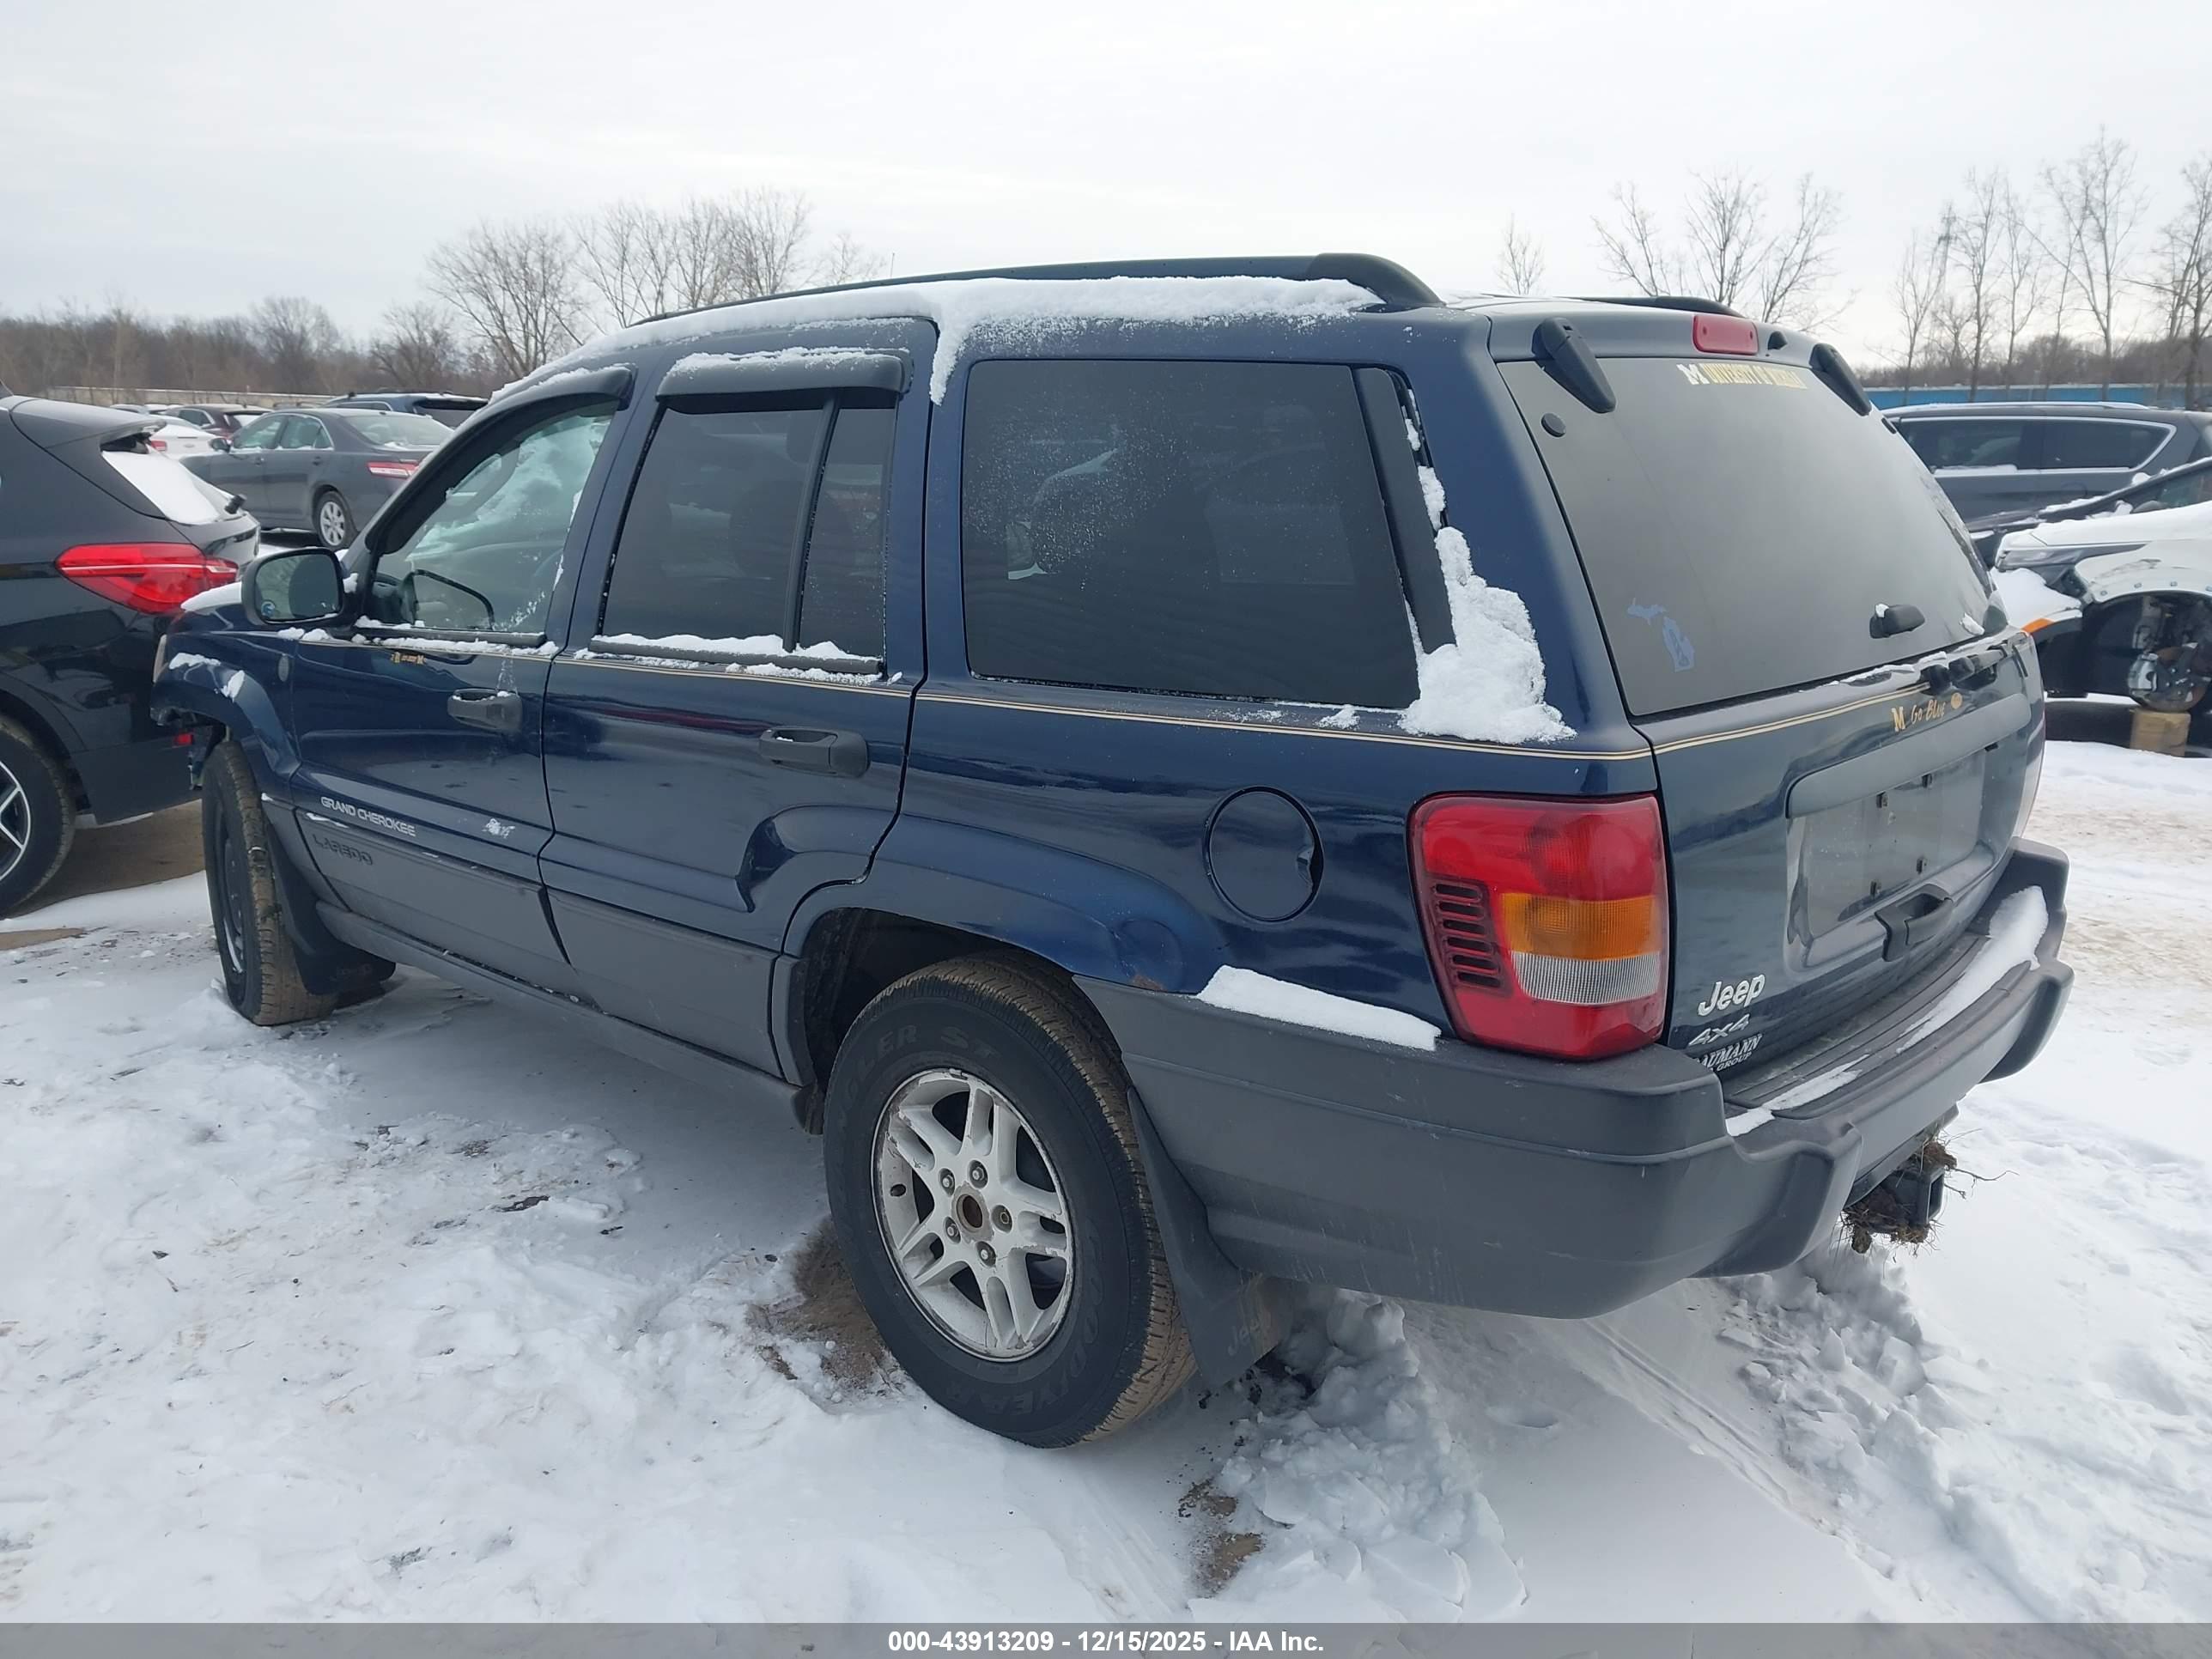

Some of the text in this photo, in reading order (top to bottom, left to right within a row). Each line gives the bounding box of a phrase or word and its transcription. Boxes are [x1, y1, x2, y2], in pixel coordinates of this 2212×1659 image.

[1891, 706, 1905, 732] M
[320, 796, 416, 837] GRAND CHEROKEE
[313, 834, 373, 866] LAREDO
[1698, 974, 1765, 1016] Jeep
[1698, 1034, 1763, 1068] AUMANN
[1717, 1051, 1753, 1072] GROUP
